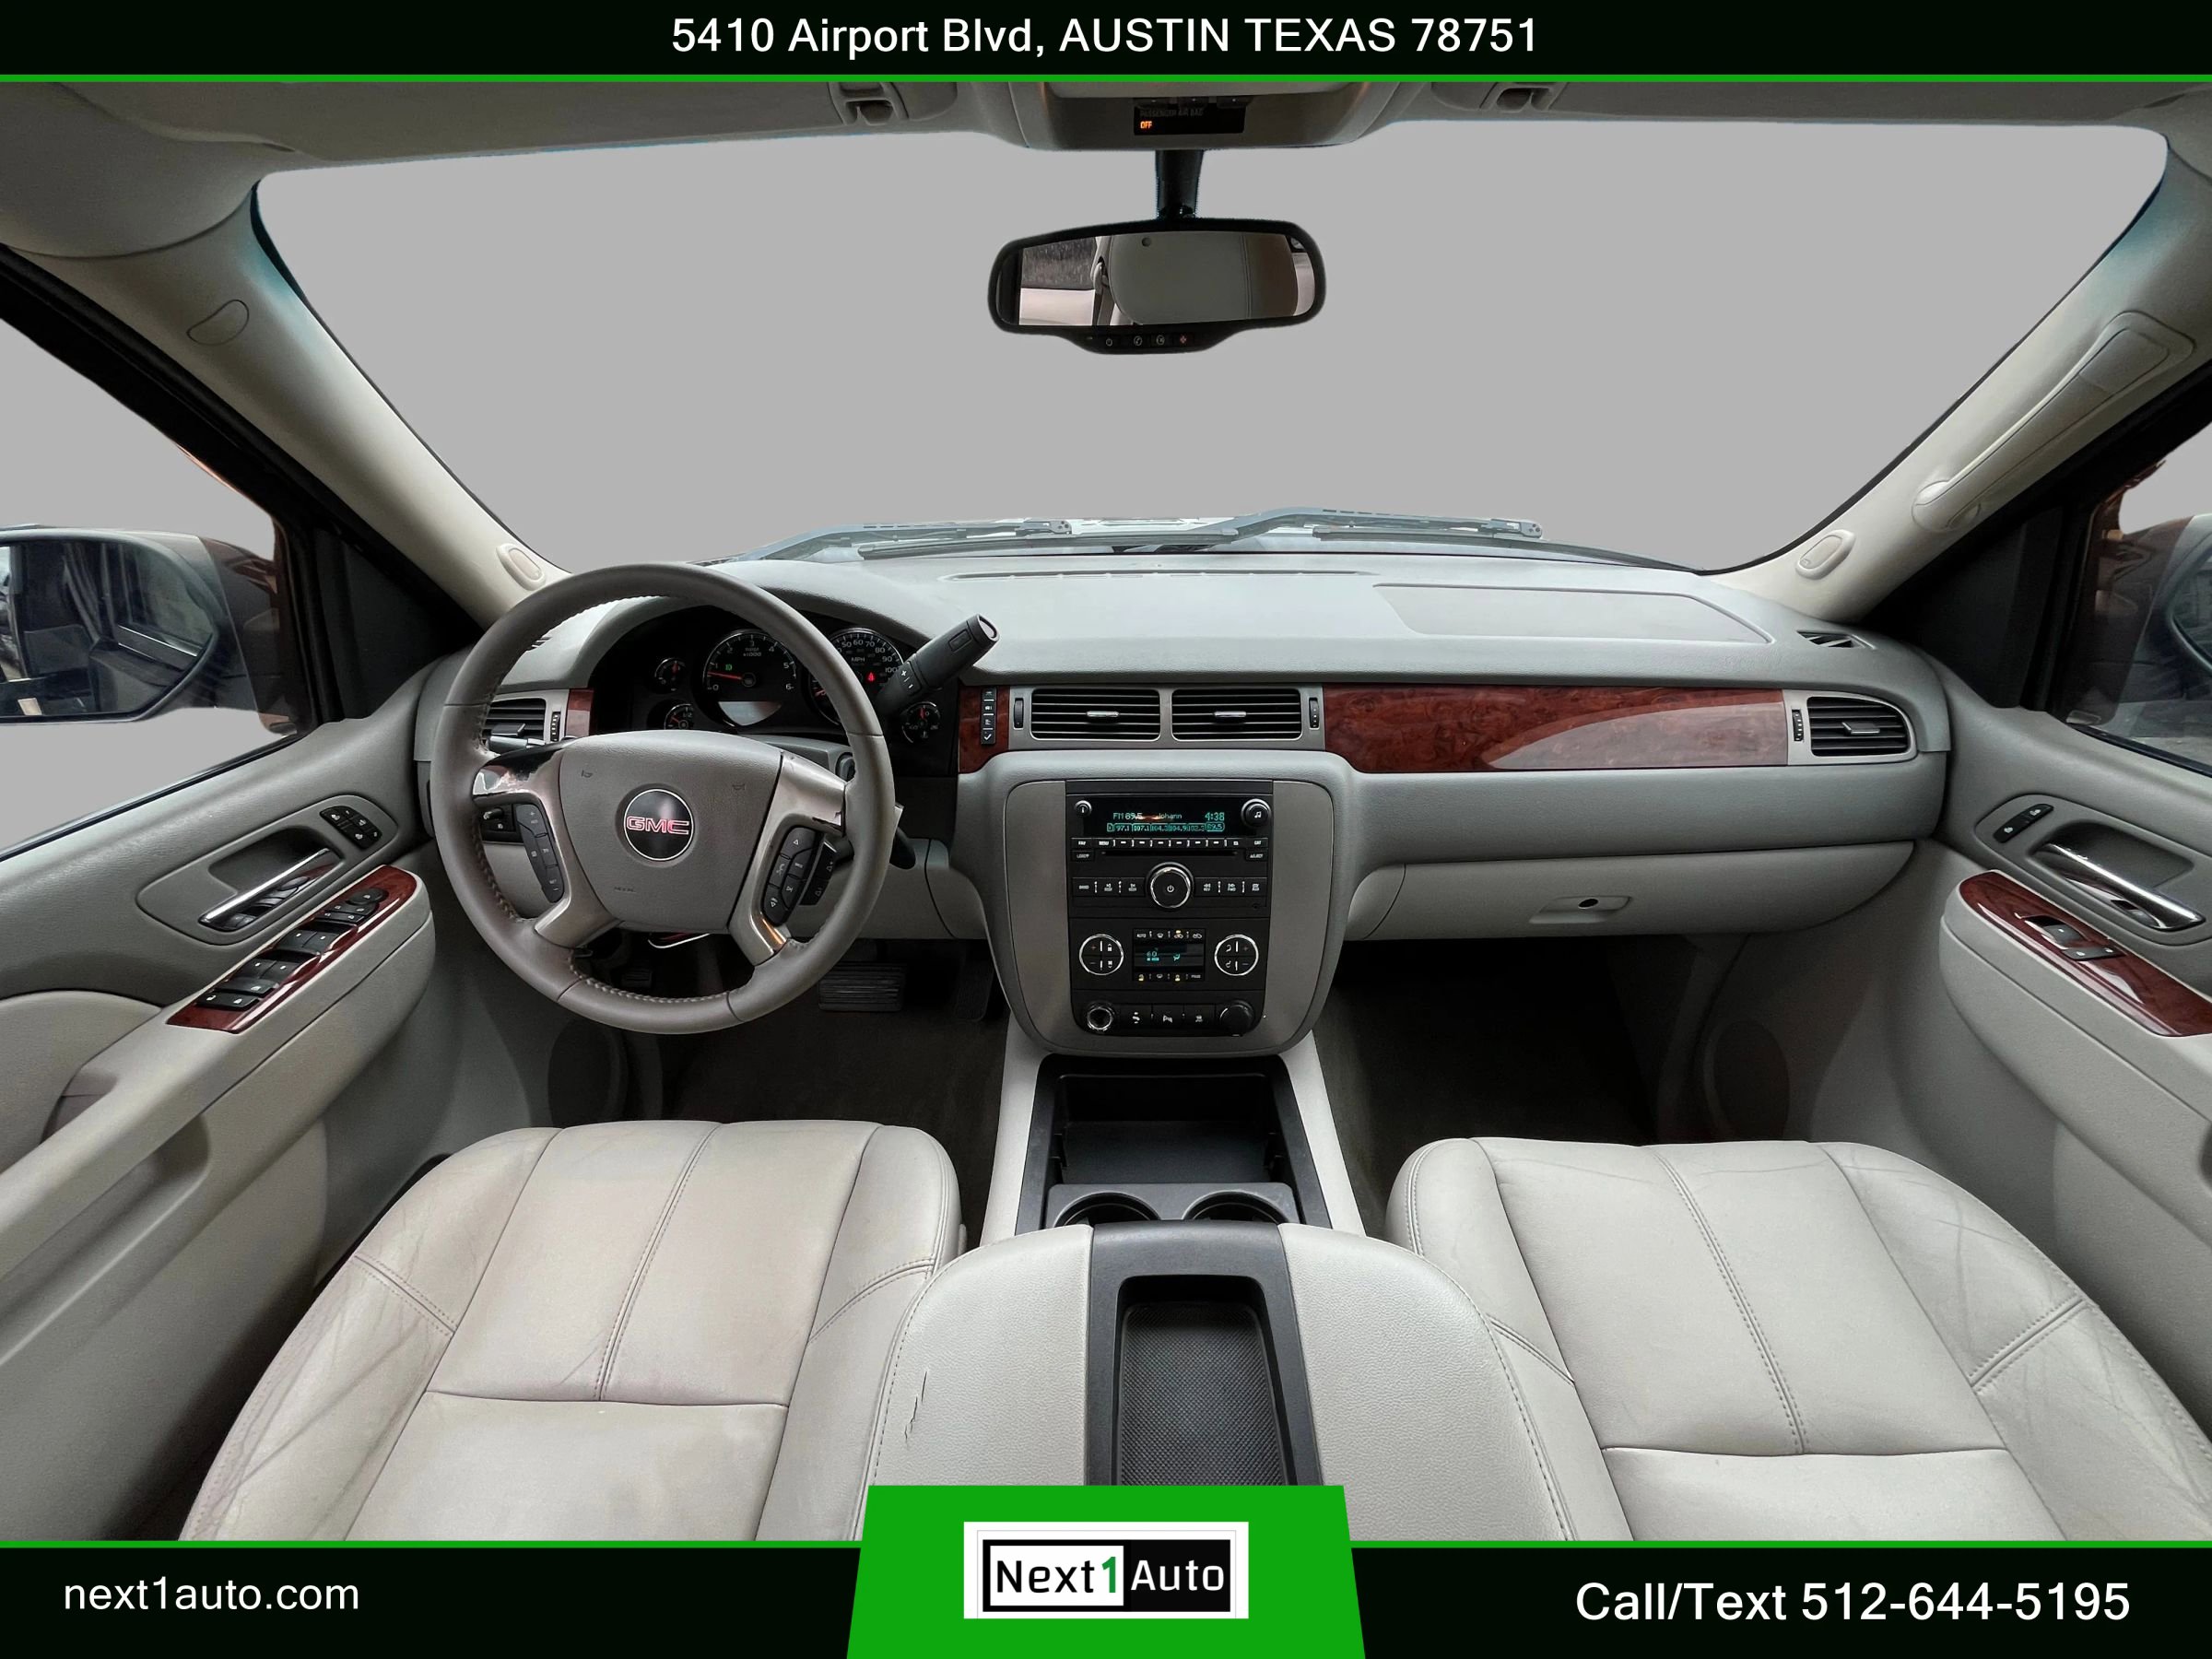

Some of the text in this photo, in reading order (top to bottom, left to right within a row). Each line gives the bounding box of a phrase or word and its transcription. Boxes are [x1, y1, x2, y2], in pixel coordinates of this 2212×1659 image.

[1140, 121, 1153, 129] OFF
[1205, 811, 1225, 821] 4:38
[625, 815, 690, 835] GMC
